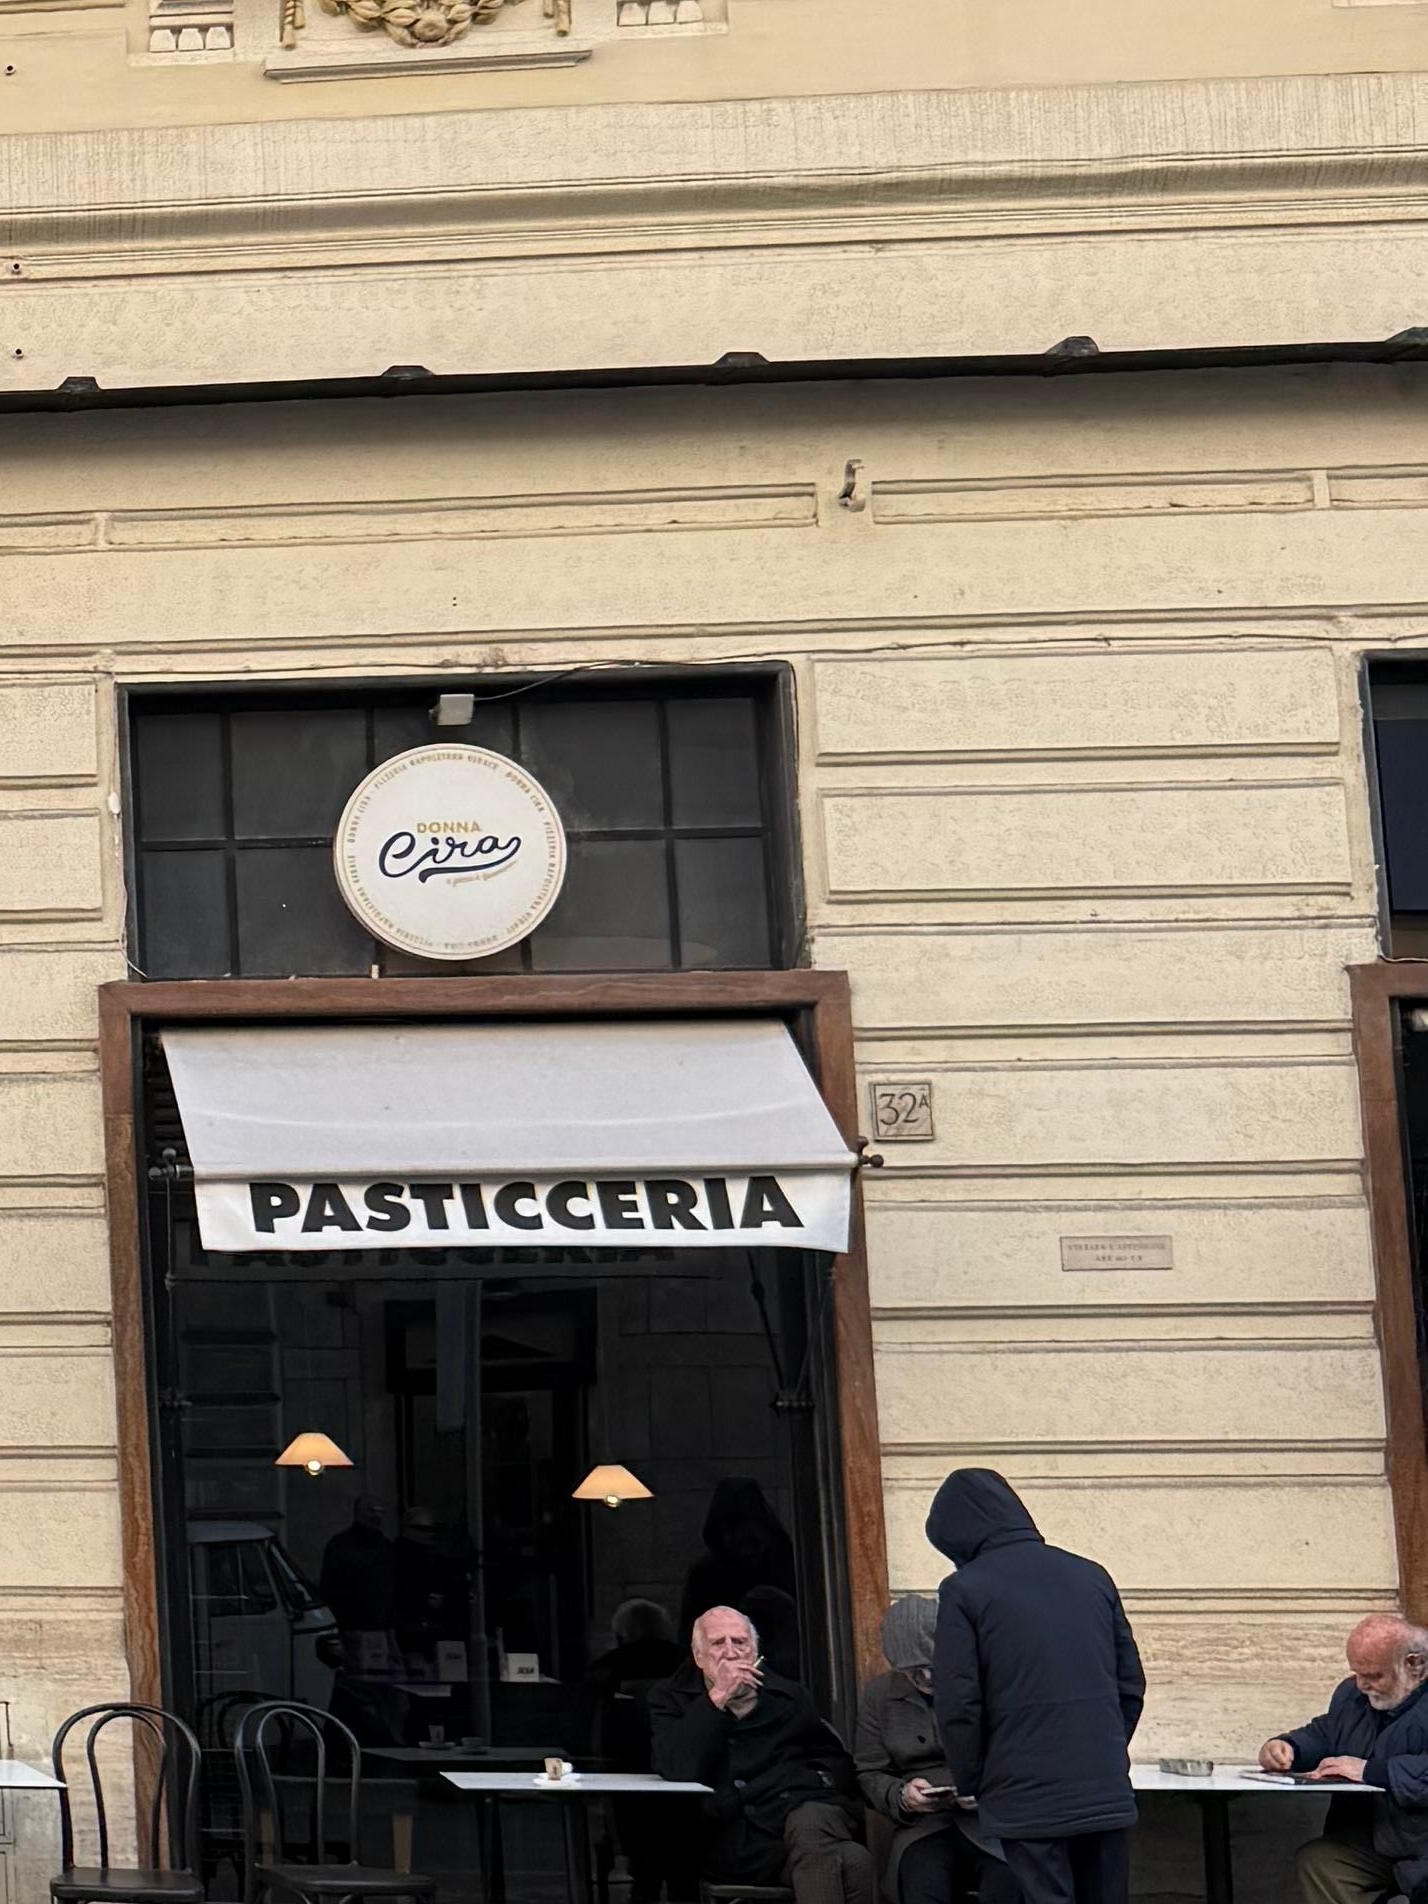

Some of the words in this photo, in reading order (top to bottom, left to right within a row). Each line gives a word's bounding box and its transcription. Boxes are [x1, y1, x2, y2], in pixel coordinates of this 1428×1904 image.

[417, 821, 482, 834] DONNA
[378, 831, 522, 884] Cira
[248, 1175, 805, 1233] PASTICCERIA
